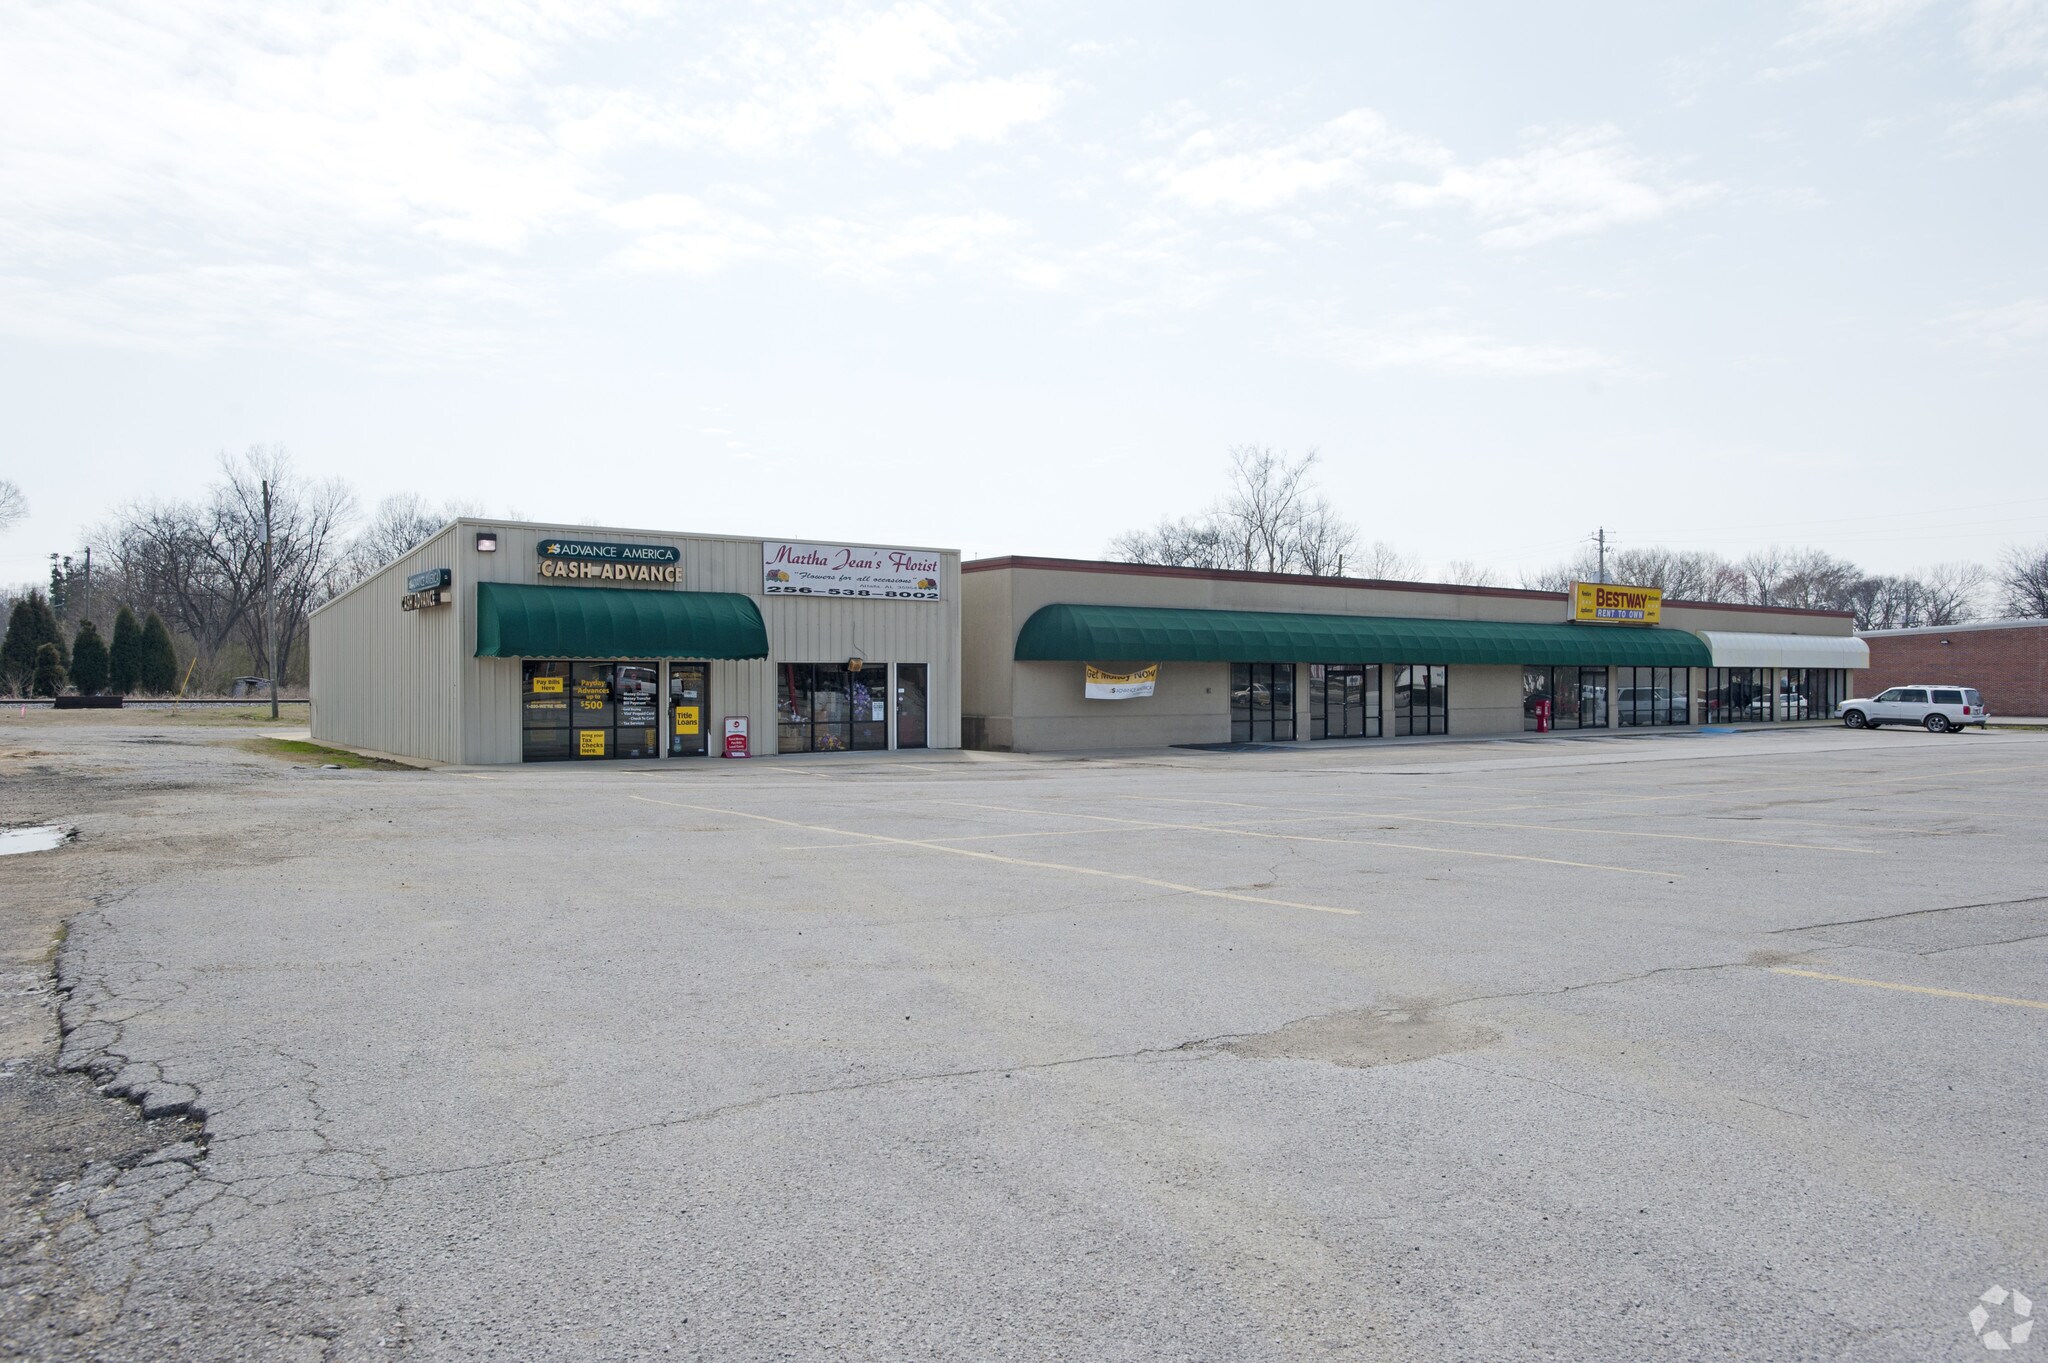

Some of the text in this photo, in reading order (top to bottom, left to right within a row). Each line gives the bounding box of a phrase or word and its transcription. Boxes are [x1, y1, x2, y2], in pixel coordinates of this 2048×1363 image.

[561, 544, 674, 560] ADVANCE AMERICA
[765, 545, 938, 573] Martha Jean's Florist
[540, 560, 683, 583] CASH ADVANCE
[838, 574, 852, 582] for
[766, 586, 939, 600] 256-538-8002
[1597, 609, 1615, 617] RENT
[1618, 609, 1627, 618] TO
[1629, 610, 1643, 619] OWN
[1086, 668, 1099, 679] Get
[1134, 669, 1156, 679] NOW
[580, 700, 603, 710] $500
